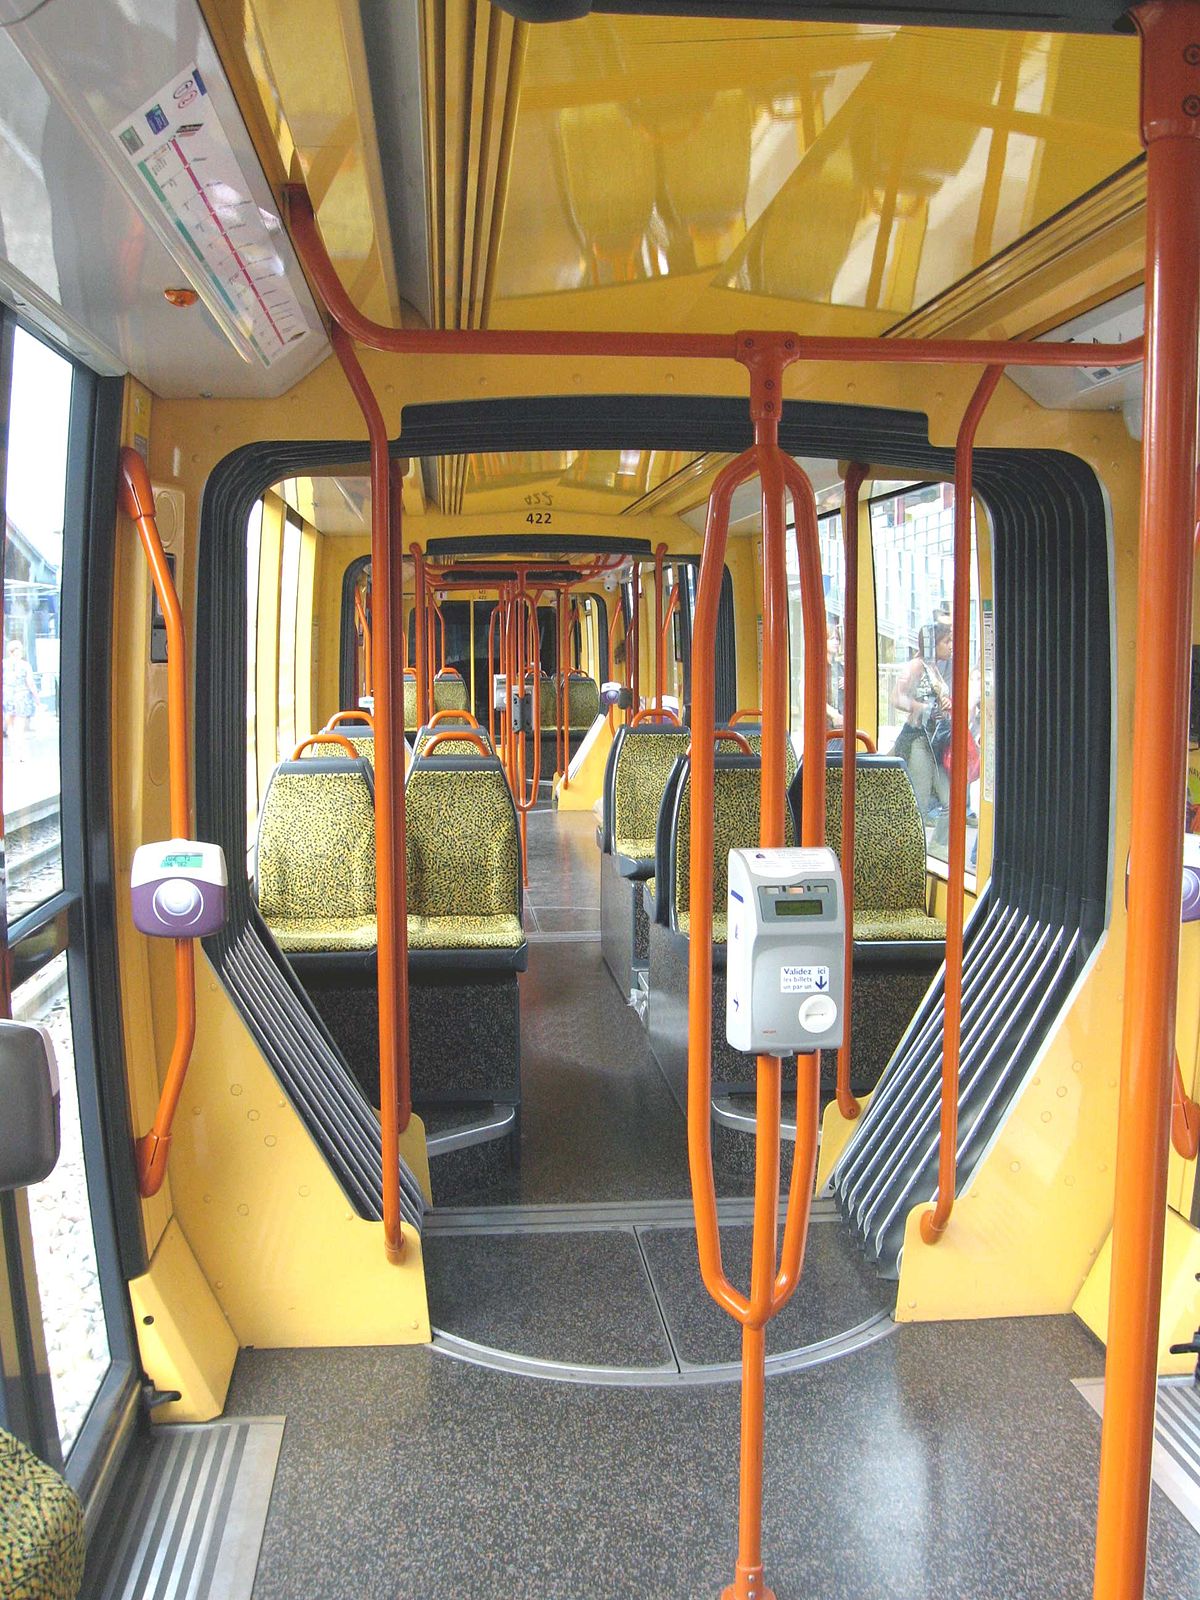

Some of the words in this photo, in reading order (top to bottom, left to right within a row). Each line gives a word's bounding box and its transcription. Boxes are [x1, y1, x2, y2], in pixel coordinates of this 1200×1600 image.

[526, 512, 552, 525] 422
[783, 967, 812, 975] Validez
[817, 967, 826, 975] ici
